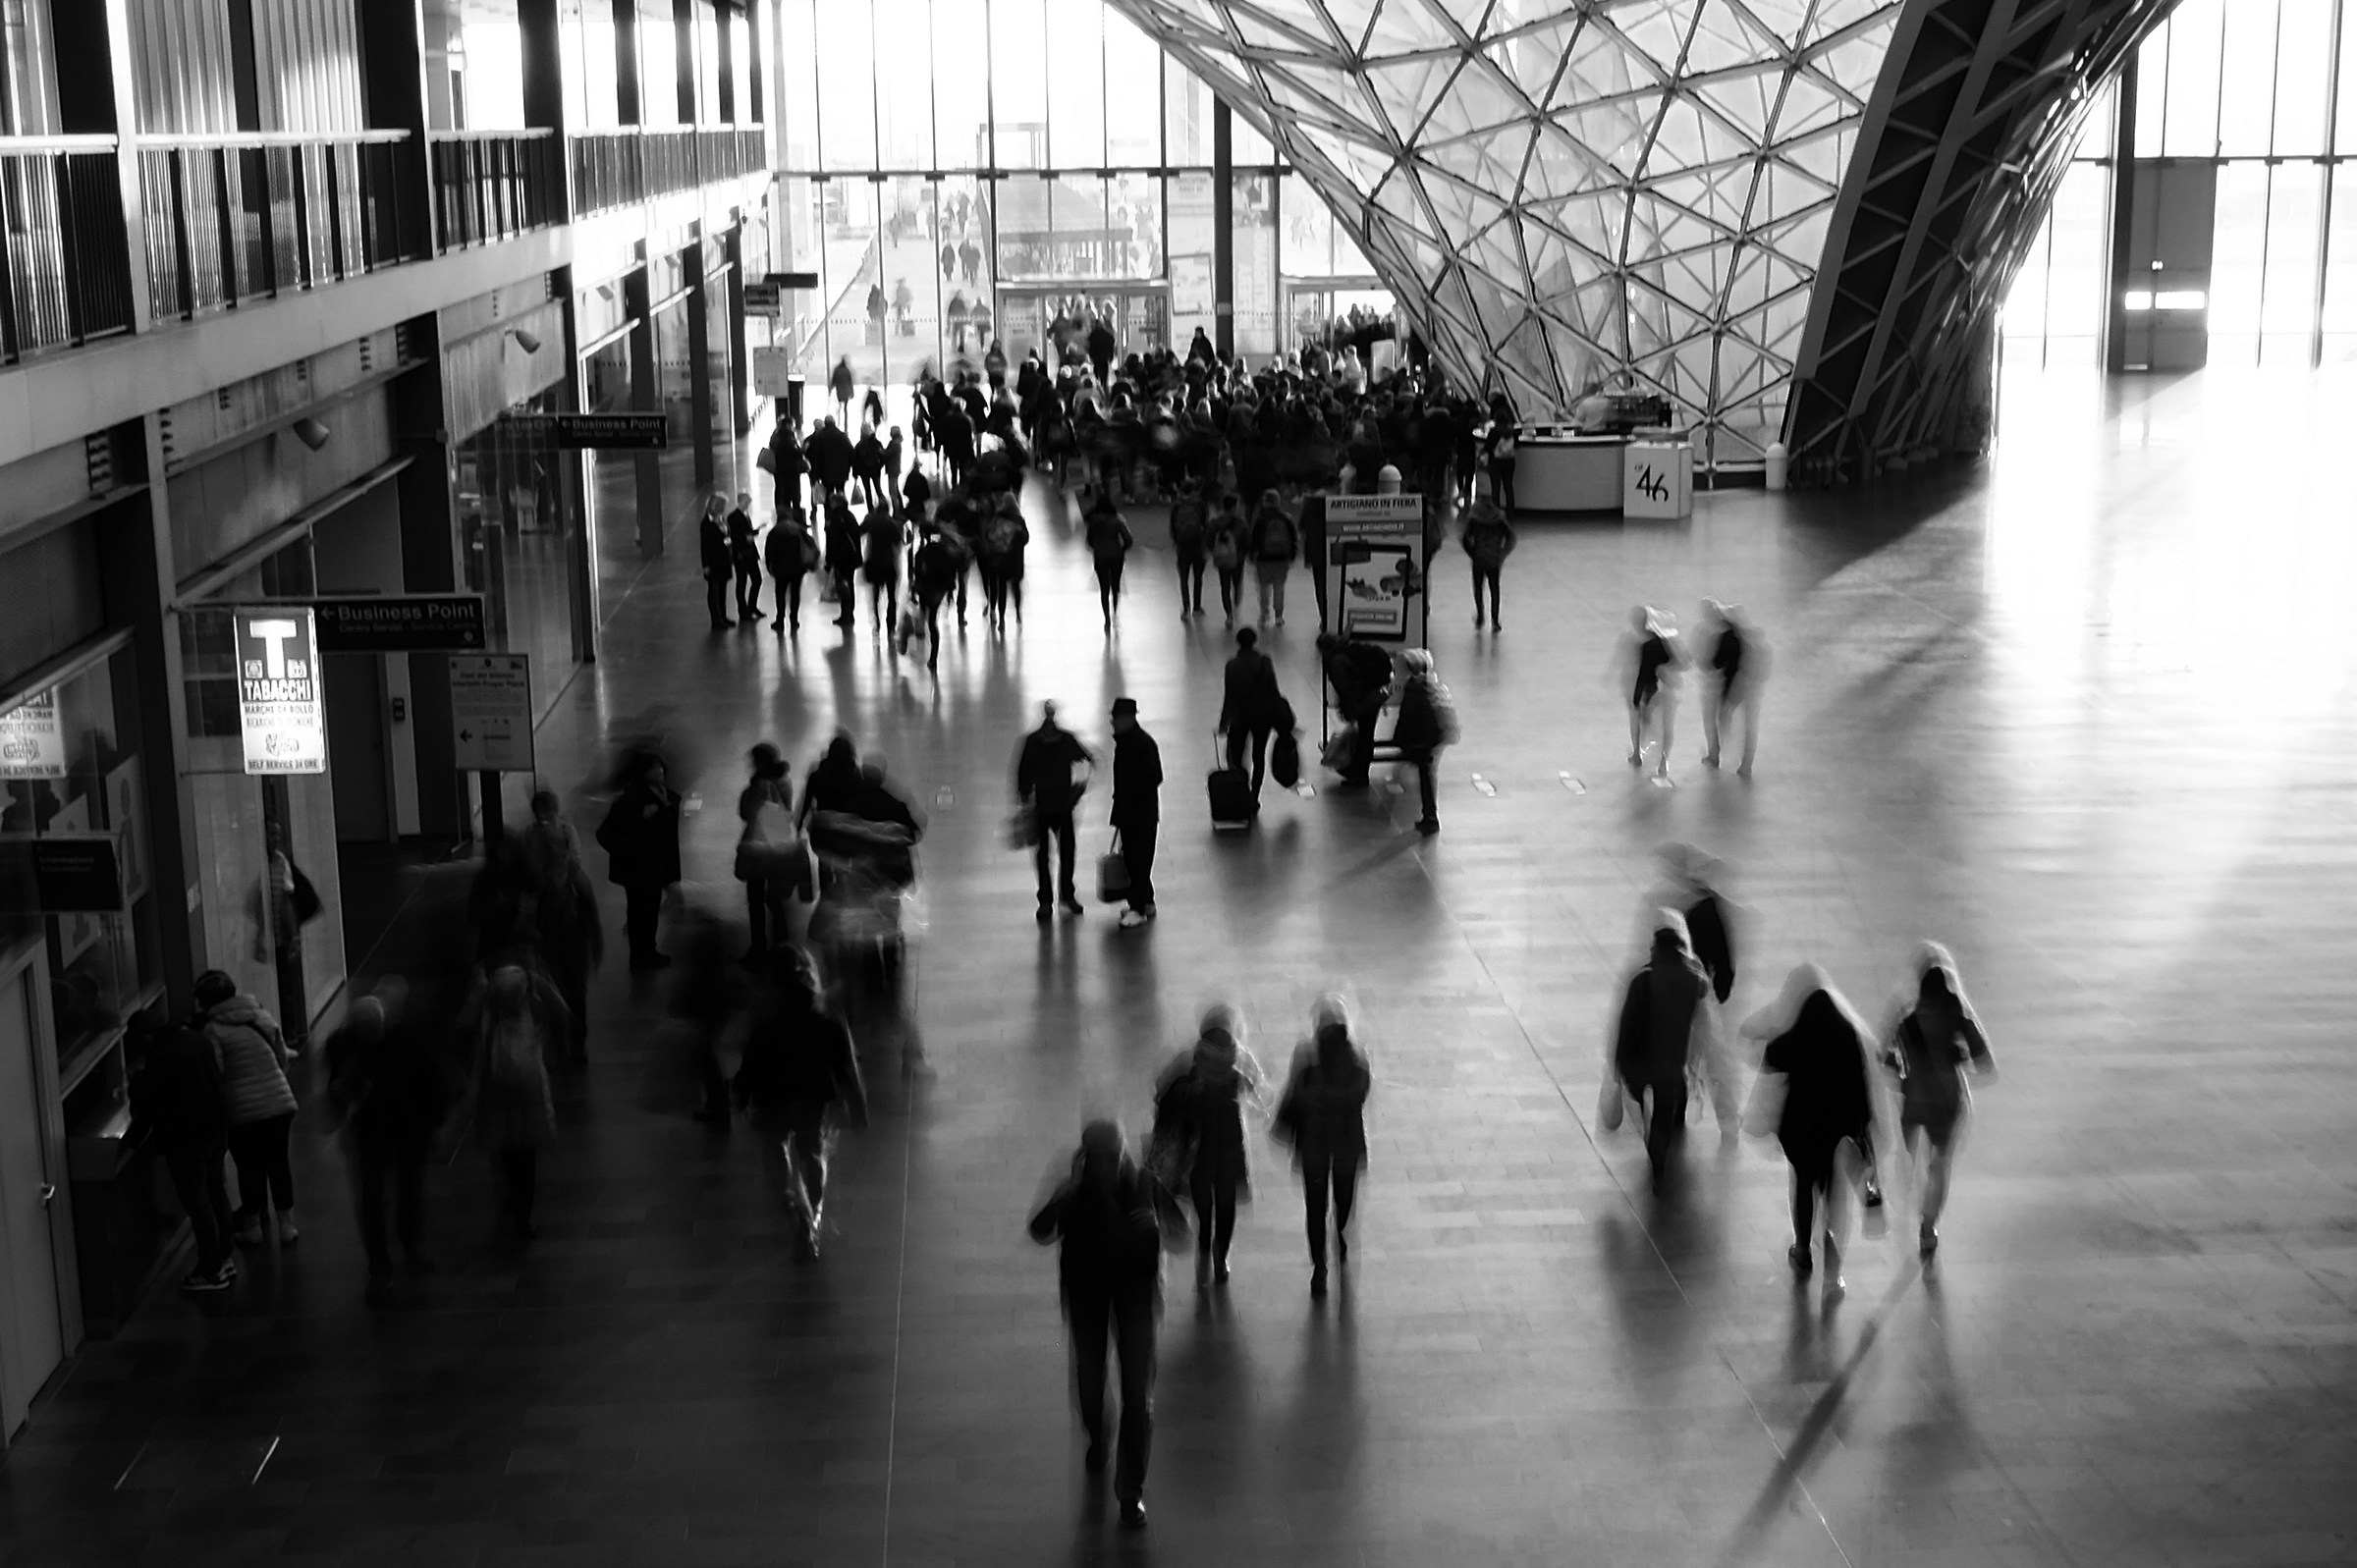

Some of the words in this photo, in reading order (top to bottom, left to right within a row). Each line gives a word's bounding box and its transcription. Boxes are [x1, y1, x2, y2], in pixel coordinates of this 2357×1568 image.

[572, 417, 627, 430] Business
[630, 417, 661, 430] Point
[1635, 463, 1669, 503] 46
[1330, 499, 1379, 509] ARTIGIANO
[1380, 499, 1391, 509] IN
[1393, 498, 1417, 508] FIERA
[338, 604, 422, 621] Business
[427, 602, 475, 620] Point
[249, 619, 297, 679] T
[244, 678, 312, 701] TABACCHI
